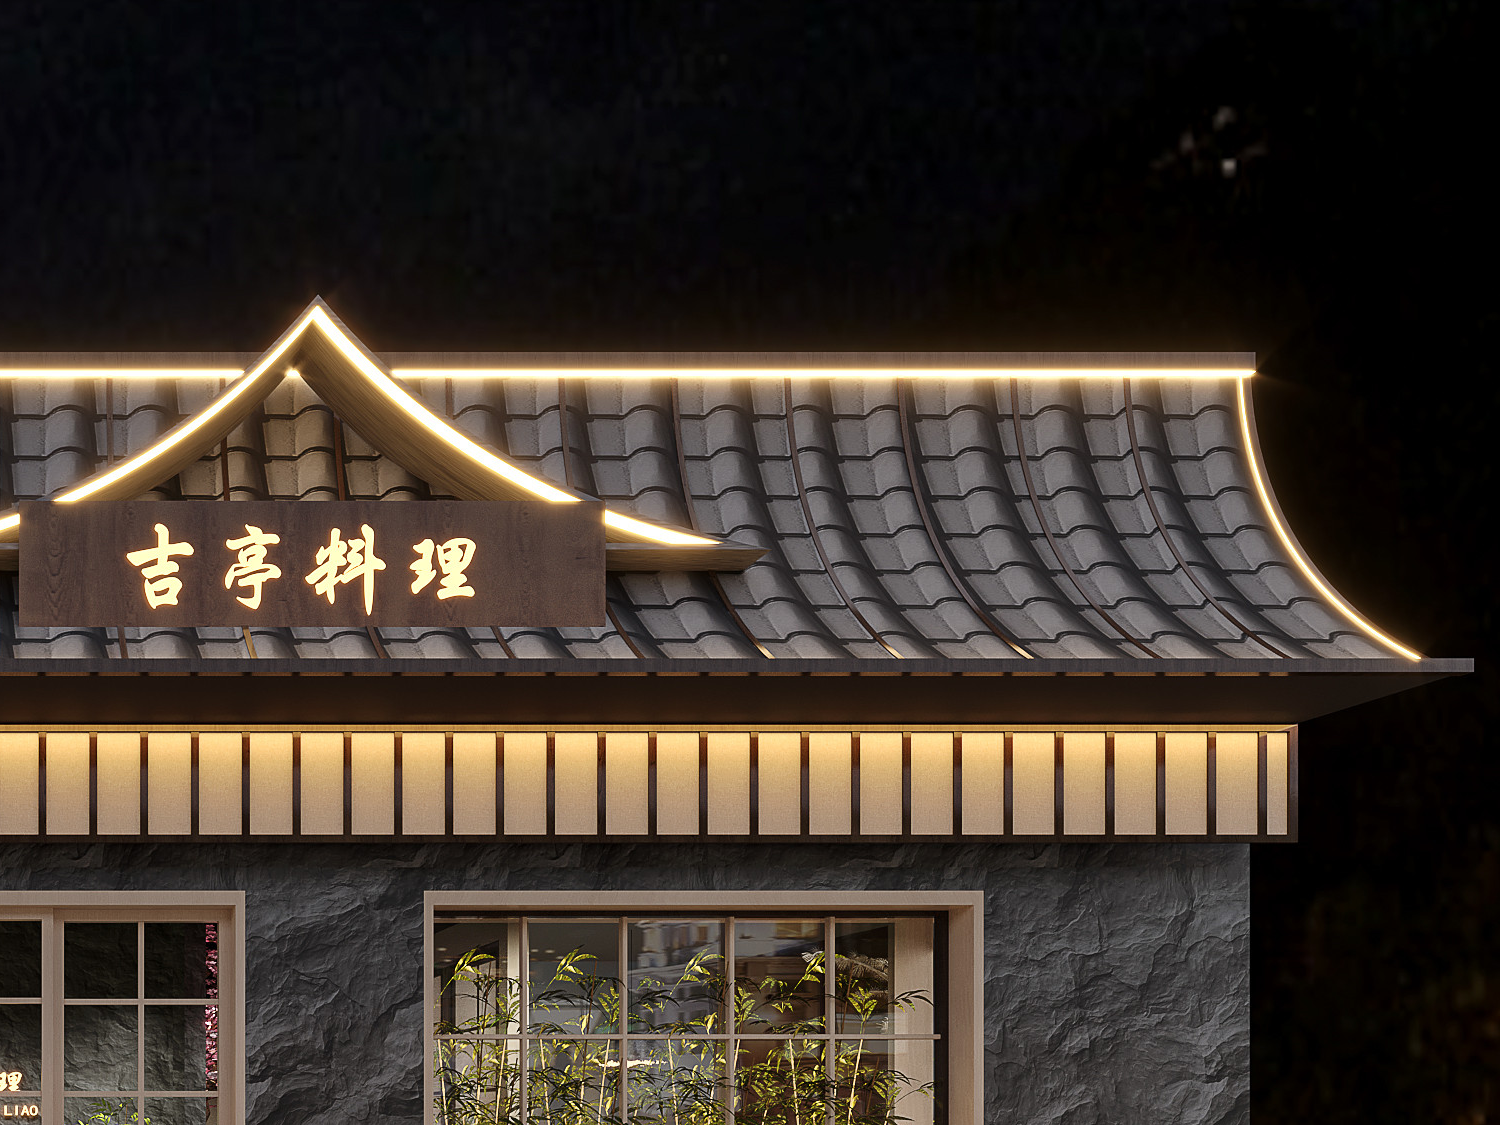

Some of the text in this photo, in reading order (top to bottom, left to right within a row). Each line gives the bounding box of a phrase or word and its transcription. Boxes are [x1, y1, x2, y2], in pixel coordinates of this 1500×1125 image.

[125, 521, 478, 617] 吉亭料理
[3, 1104, 39, 1117] LIAO
